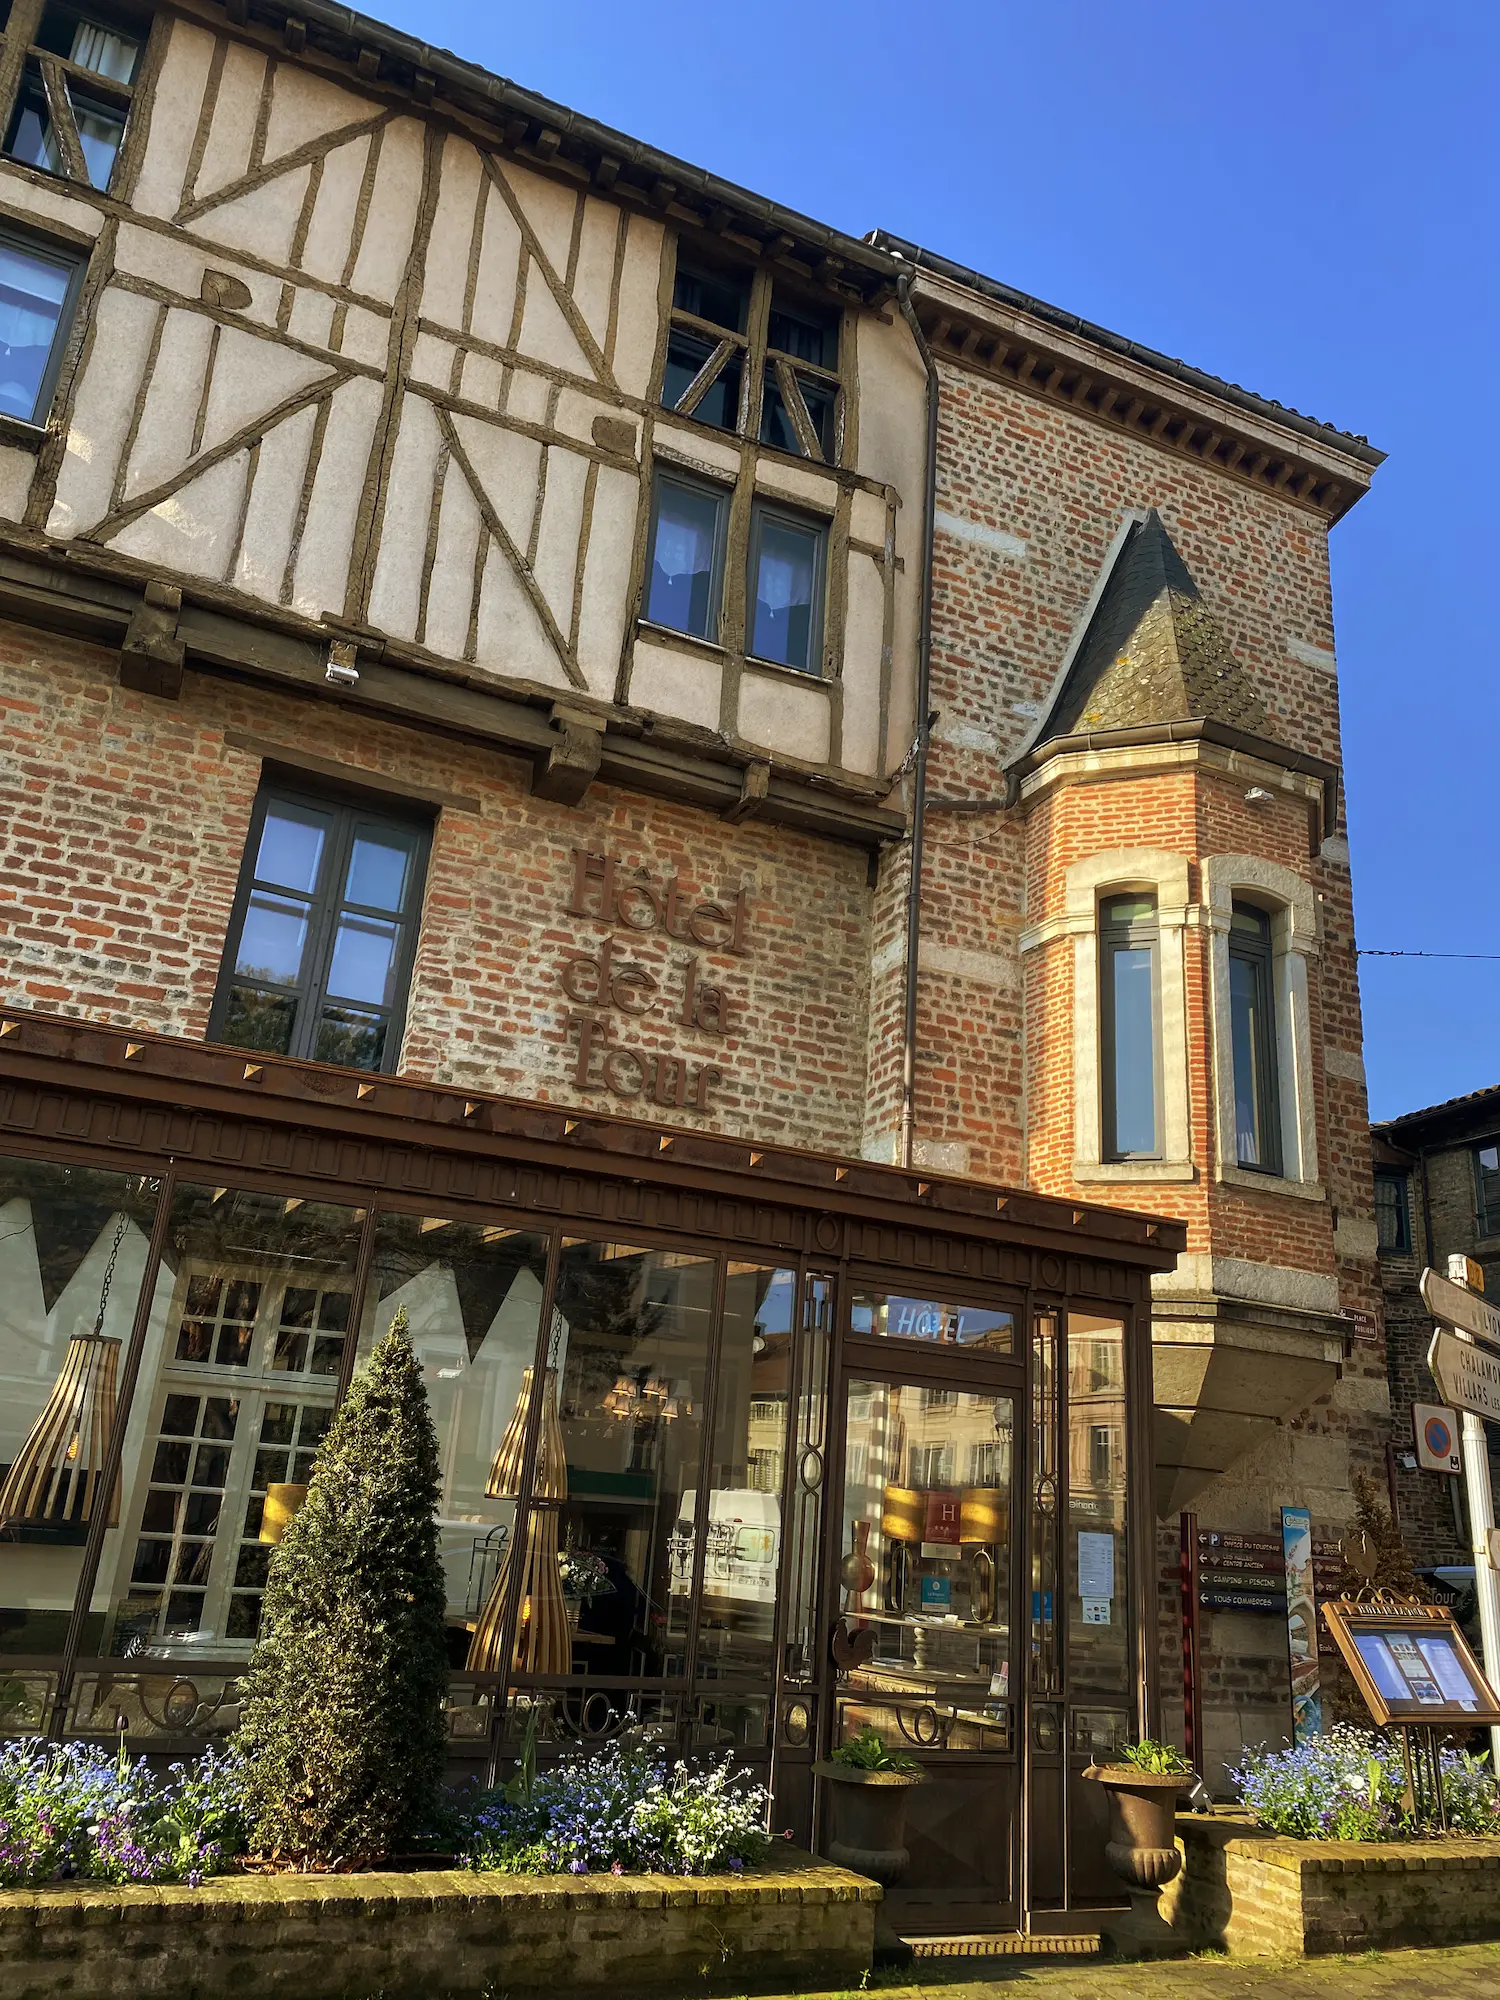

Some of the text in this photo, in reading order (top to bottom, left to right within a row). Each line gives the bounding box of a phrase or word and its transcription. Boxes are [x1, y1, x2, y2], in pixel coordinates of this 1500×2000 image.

[564, 848, 748, 957] Hôtel
[562, 934, 731, 1036] de la
[564, 1013, 722, 1112] Tour
[897, 1303, 966, 1344] HÔTEL
[1452, 1372, 1489, 1406] VILLARS
[941, 1503, 956, 1522] H
[1210, 1533, 1218, 1545] P
[1213, 1575, 1243, 1585] CAMPING
[1248, 1578, 1276, 1588] PISCINE
[1213, 1595, 1273, 1607] TOUS COMMERCES
[1430, 1587, 1456, 1606] Tour
